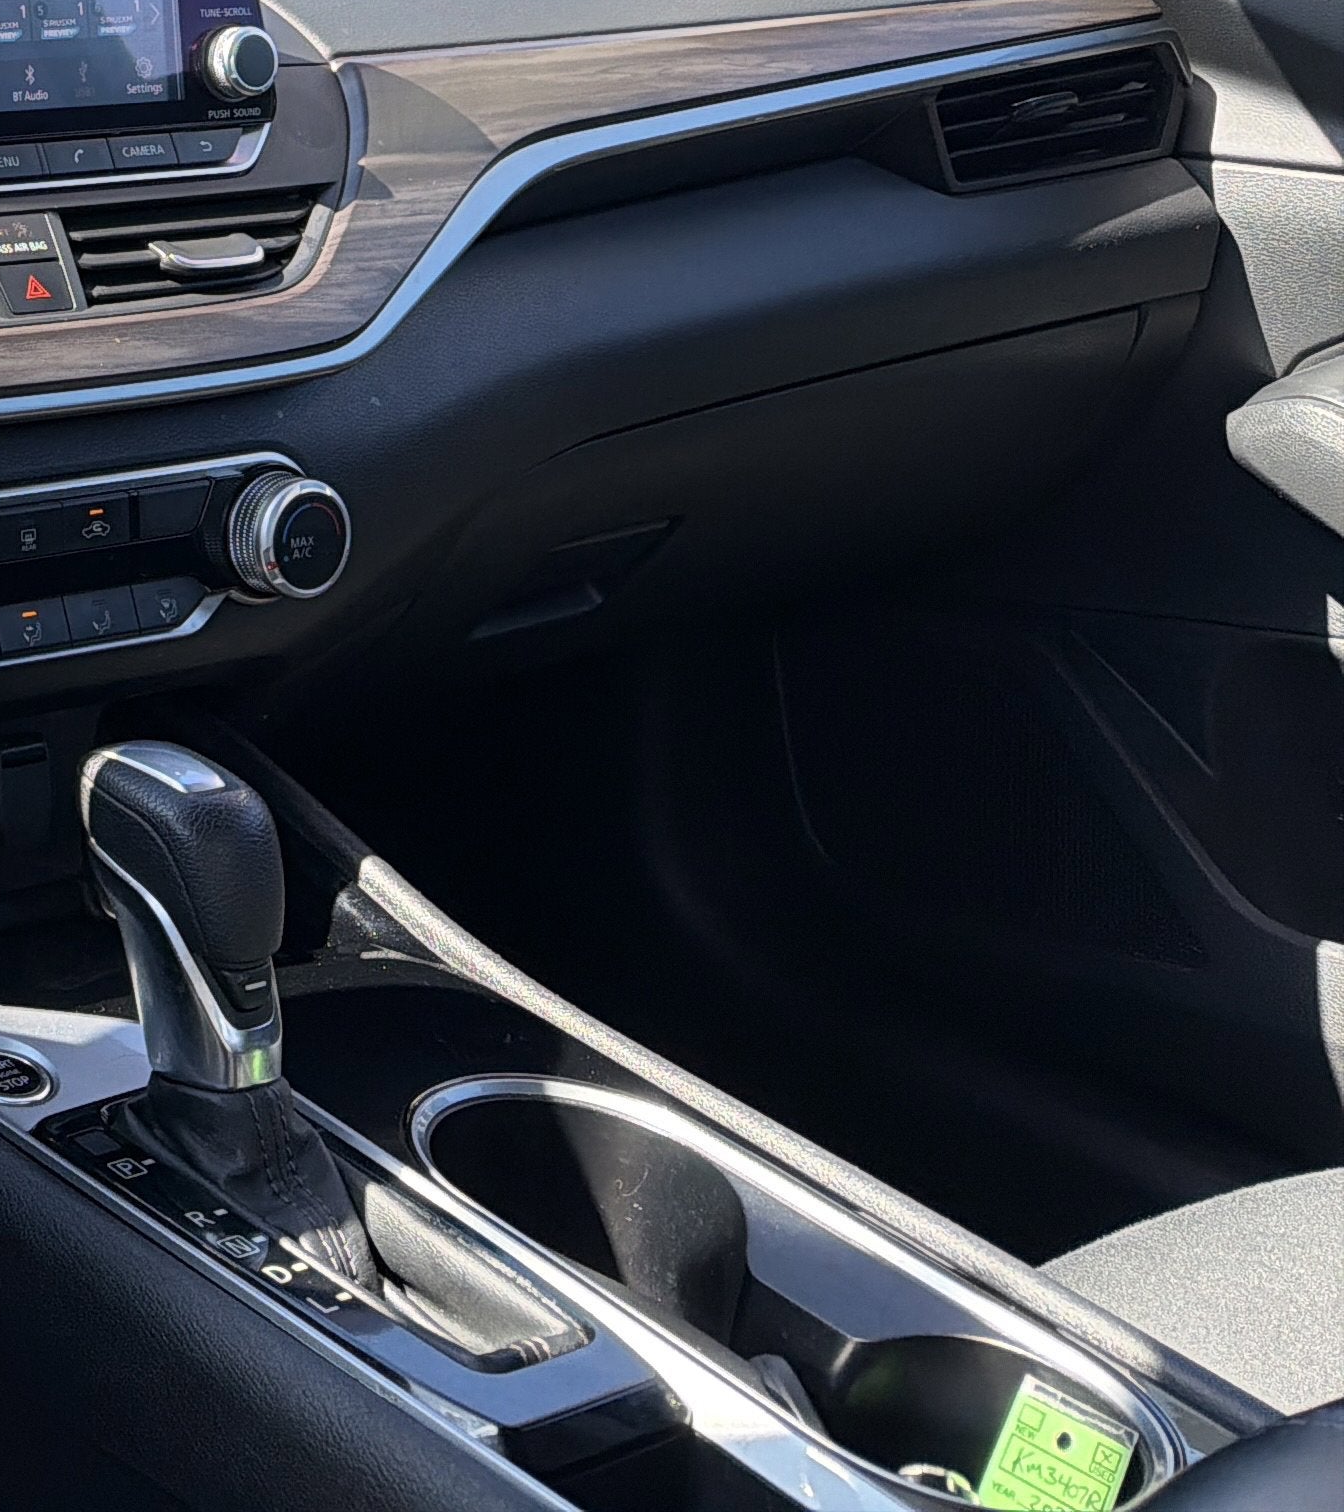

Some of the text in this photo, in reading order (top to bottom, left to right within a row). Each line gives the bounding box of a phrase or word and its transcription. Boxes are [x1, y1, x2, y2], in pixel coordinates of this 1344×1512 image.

[13, 89, 49, 102] BT Audio
[126, 83, 163, 96] Settings
[207, 107, 261, 120] PUSH SOUND
[122, 144, 165, 159] CAMERA
[14, 242, 29, 253] AIR
[29, 241, 48, 252] BAG
[290, 536, 315, 548] MAX
[292, 547, 312, 560] A/C
[184, 1211, 216, 1228] R
[261, 1265, 293, 1284] D
[306, 1296, 340, 1314] L
[1089, 1461, 1116, 1483] USED
